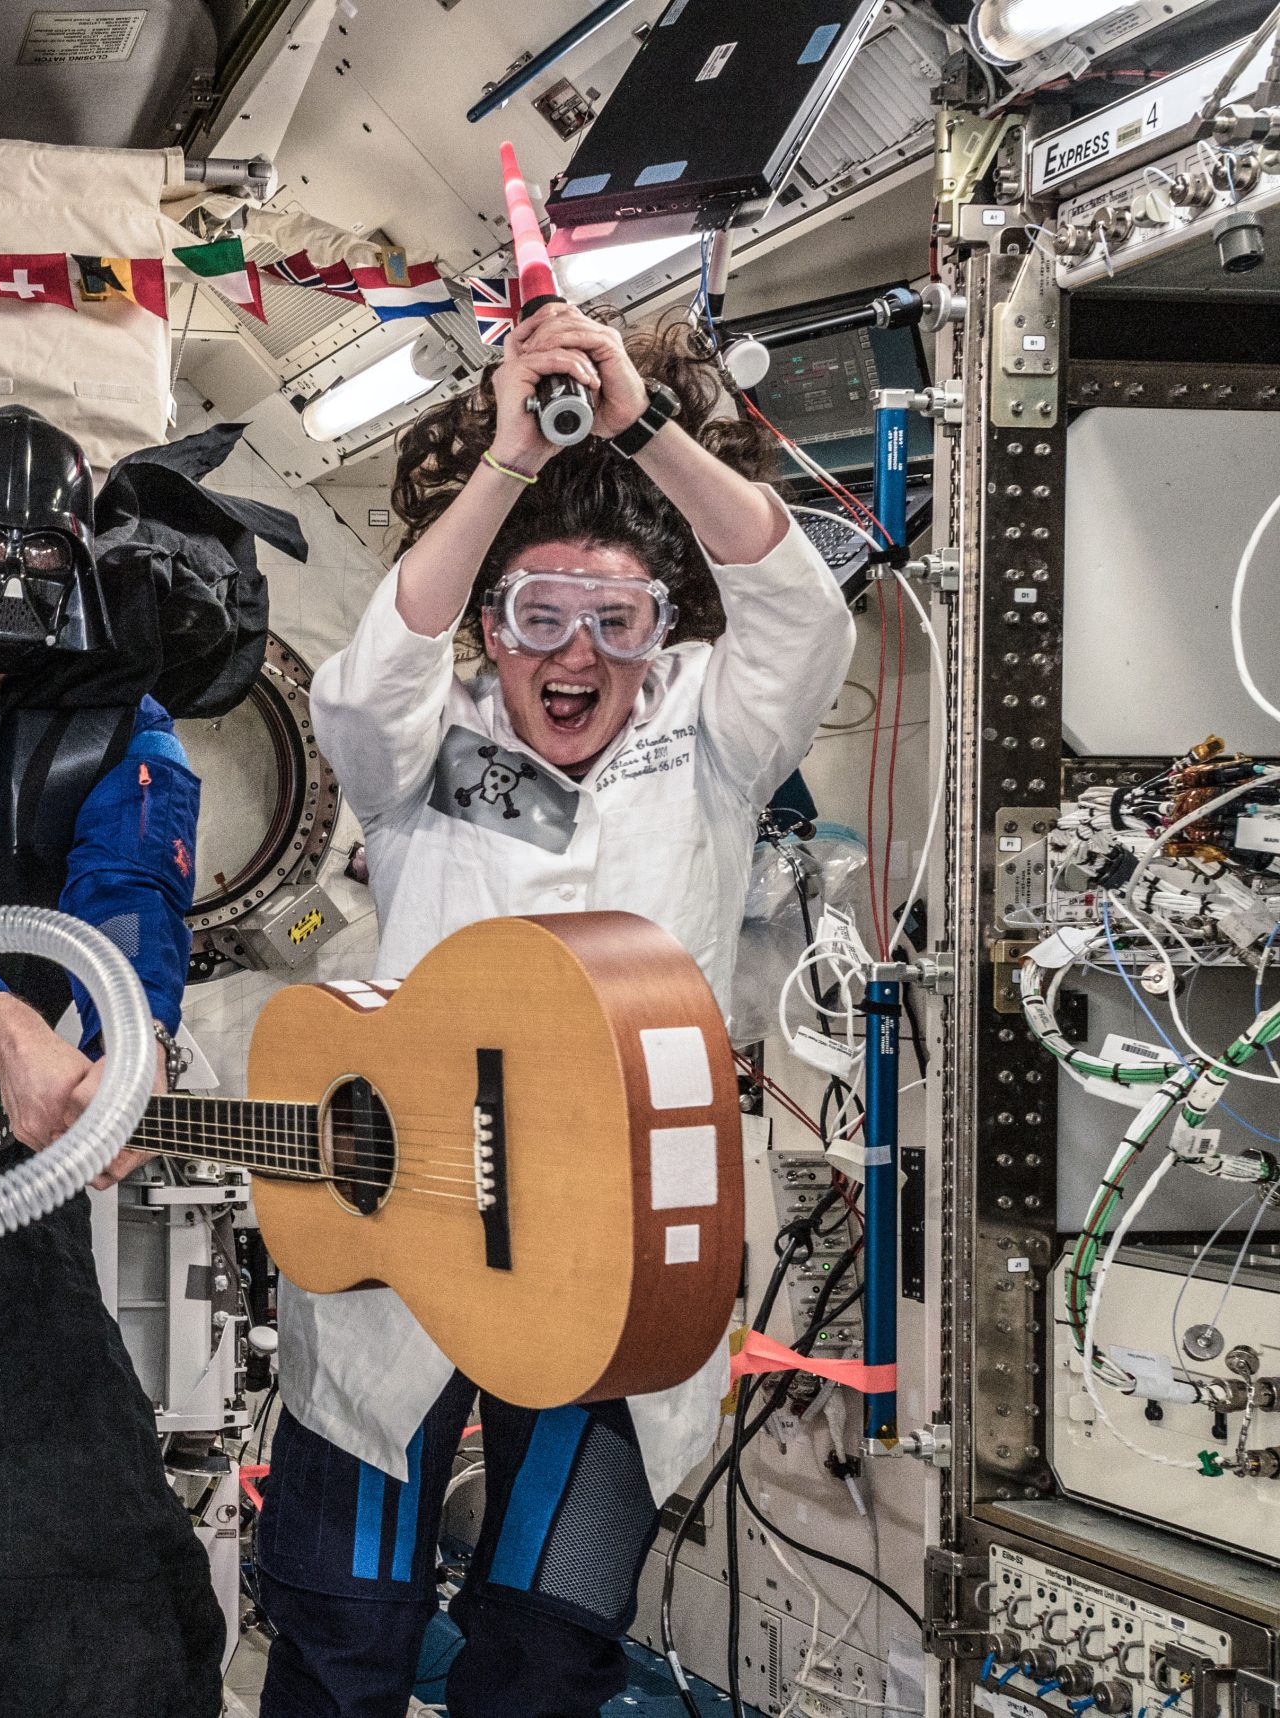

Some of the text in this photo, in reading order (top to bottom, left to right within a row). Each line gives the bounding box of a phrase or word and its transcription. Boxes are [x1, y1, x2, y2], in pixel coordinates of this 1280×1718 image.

[1044, 102, 1158, 178] EXPRESS 4
[1002, 1550, 1024, 1566] Elite-S2
[1044, 1567, 1067, 1582] Interface
[1072, 1577, 1104, 1596] Management
[1103, 1589, 1115, 1601] Unit
